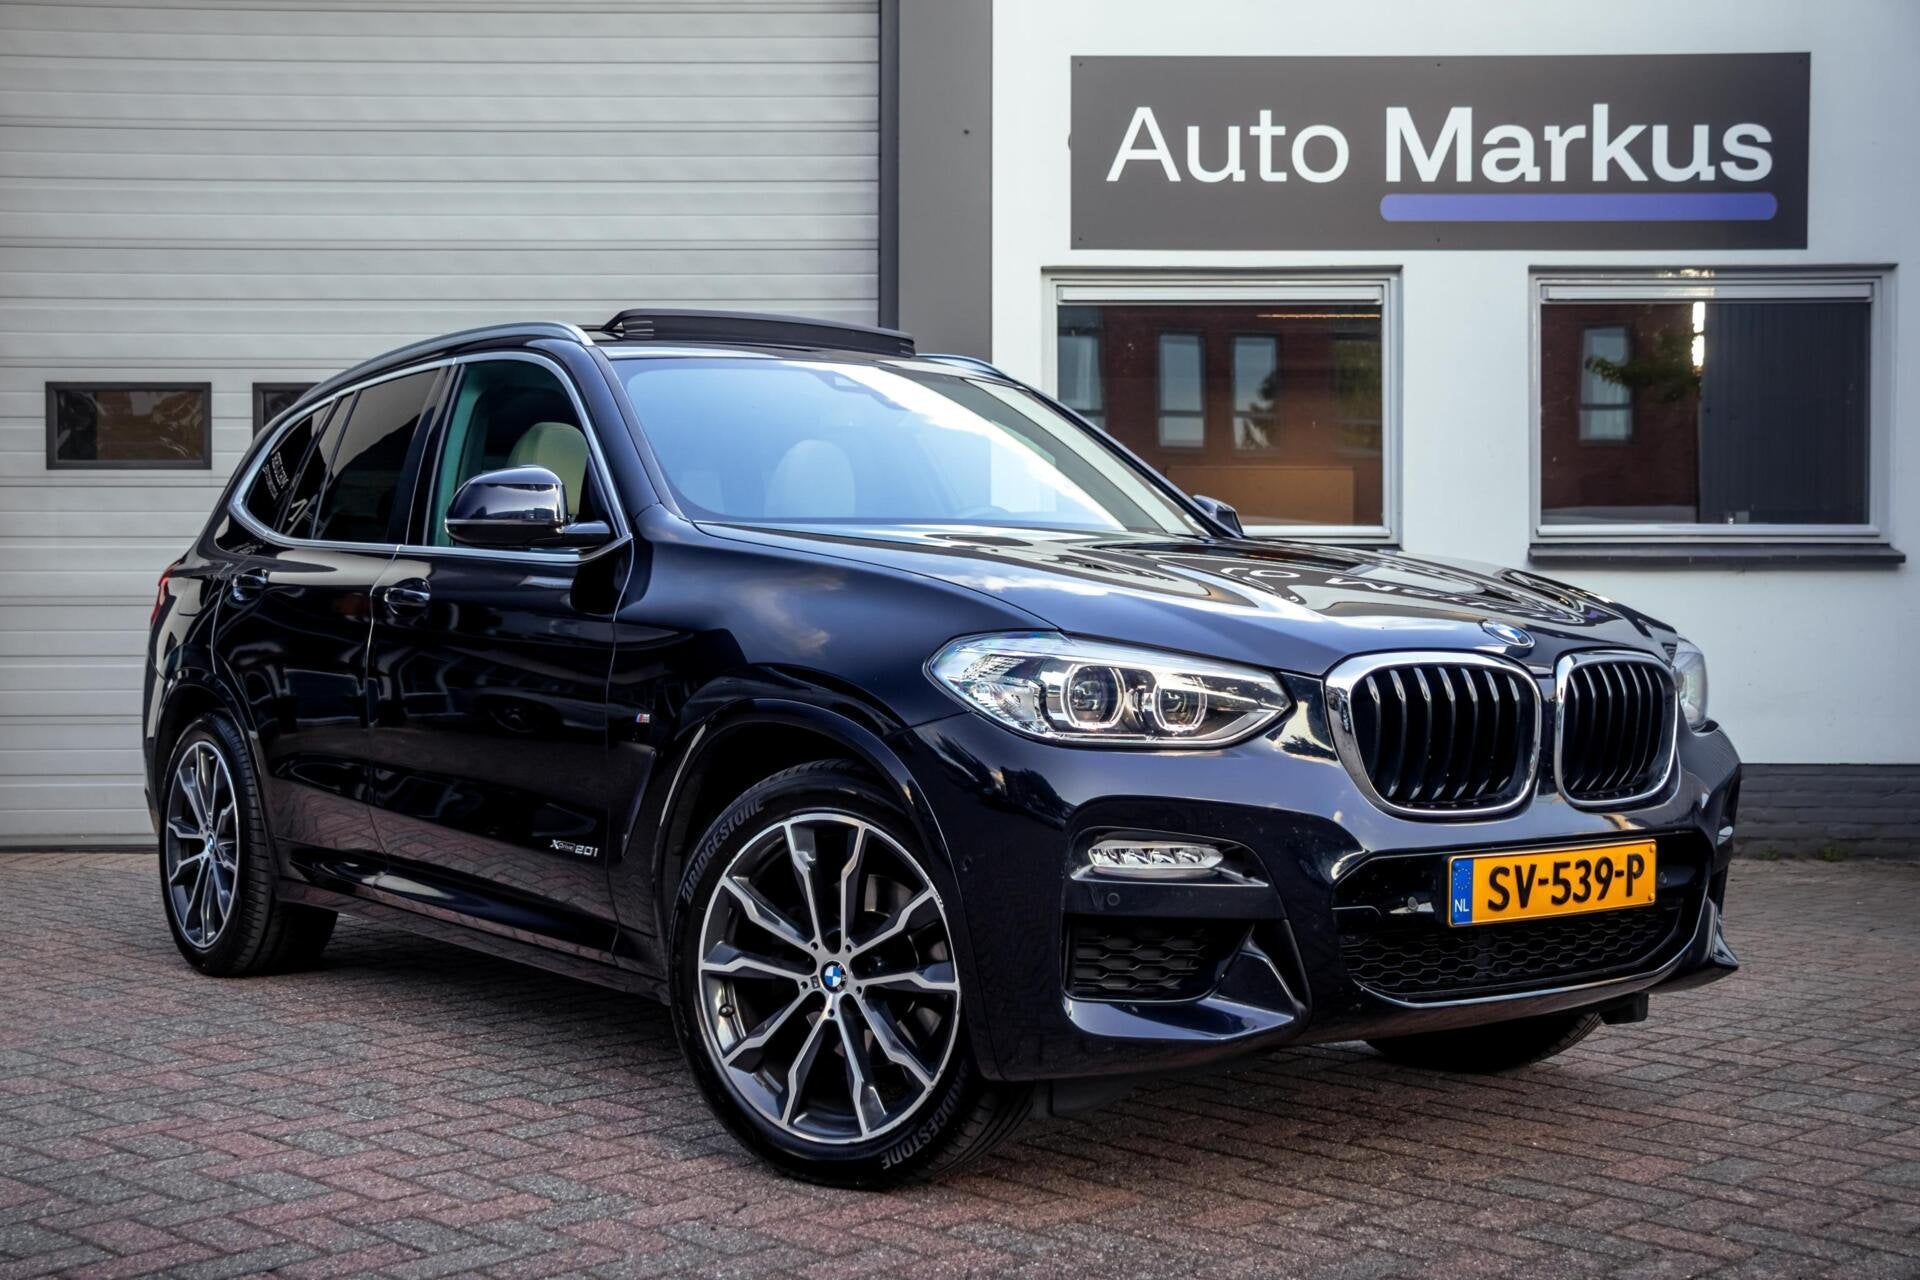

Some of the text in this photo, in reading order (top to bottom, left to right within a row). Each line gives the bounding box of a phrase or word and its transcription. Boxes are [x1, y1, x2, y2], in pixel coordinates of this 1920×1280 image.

[1106, 103, 1774, 183] Auto Markus
[680, 799, 764, 904] BRIDGESTONE
[1487, 853, 1645, 912] SV-539-P
[1454, 898, 1470, 913] NL
